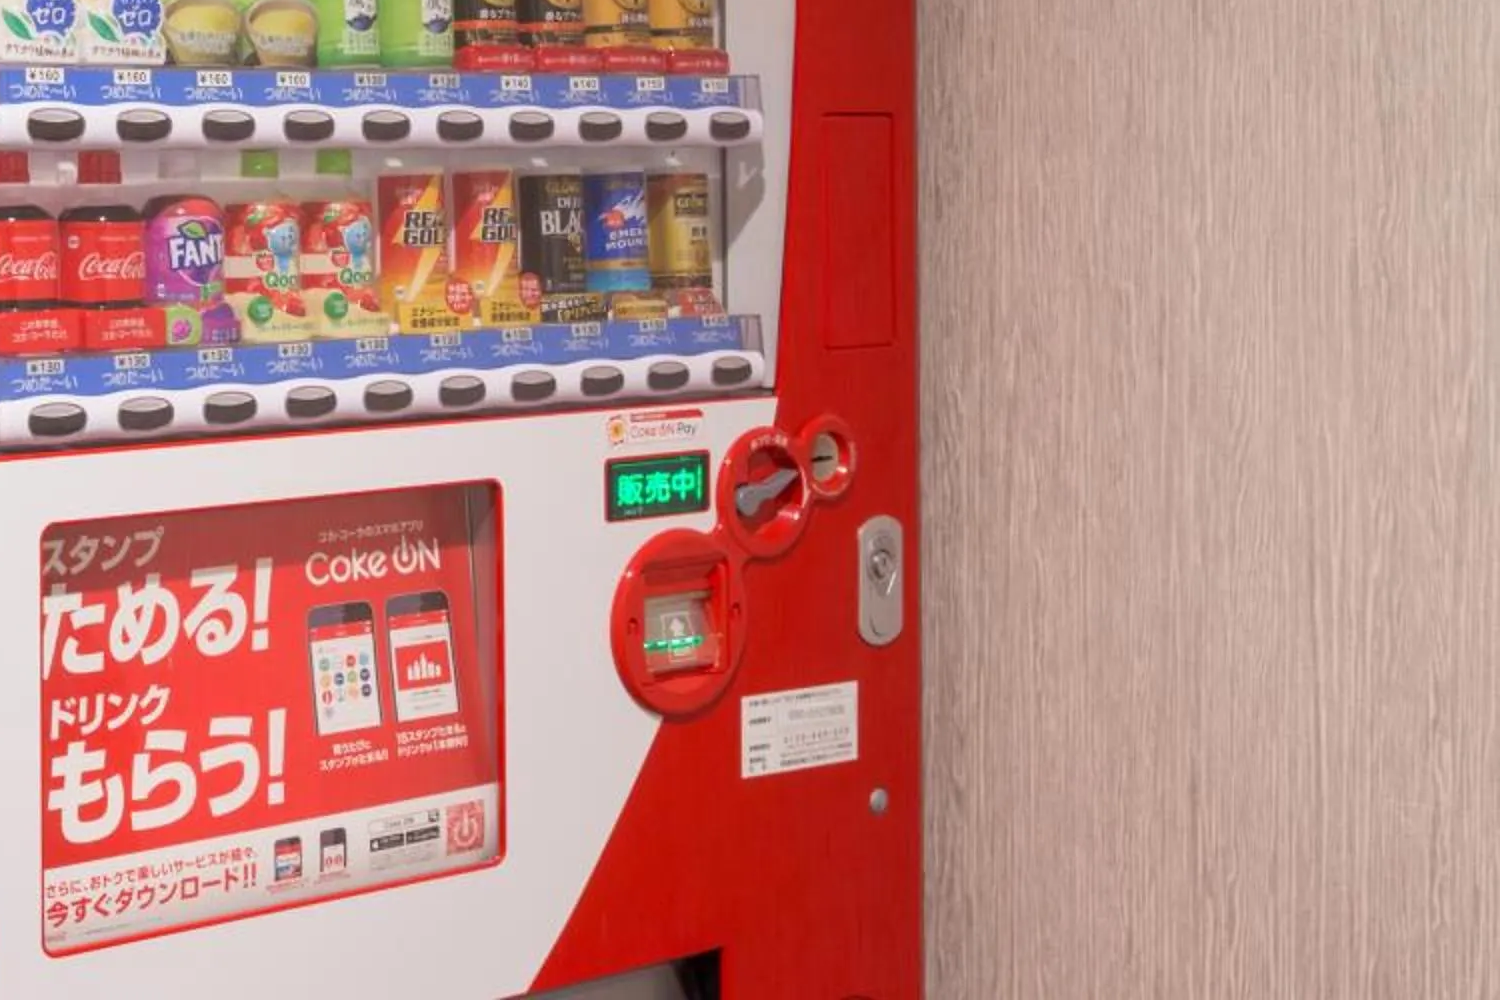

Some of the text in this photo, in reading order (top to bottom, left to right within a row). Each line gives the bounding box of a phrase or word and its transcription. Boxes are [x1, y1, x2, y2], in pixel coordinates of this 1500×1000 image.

[33, 7, 66, 24] ゼロ
[120, 10, 152, 26] ゼロ
[78, 251, 145, 281] Coca-Col
[677, 422, 696, 436] Pay
[617, 468, 695, 506] 販売中
[43, 525, 165, 576] スタンプ
[305, 535, 441, 586] Coke ON
[43, 557, 273, 681] ためる!
[50, 684, 171, 740] ドリンク
[48, 707, 287, 844] もらう!
[47, 862, 257, 928] 今すぐダウンロード!!
